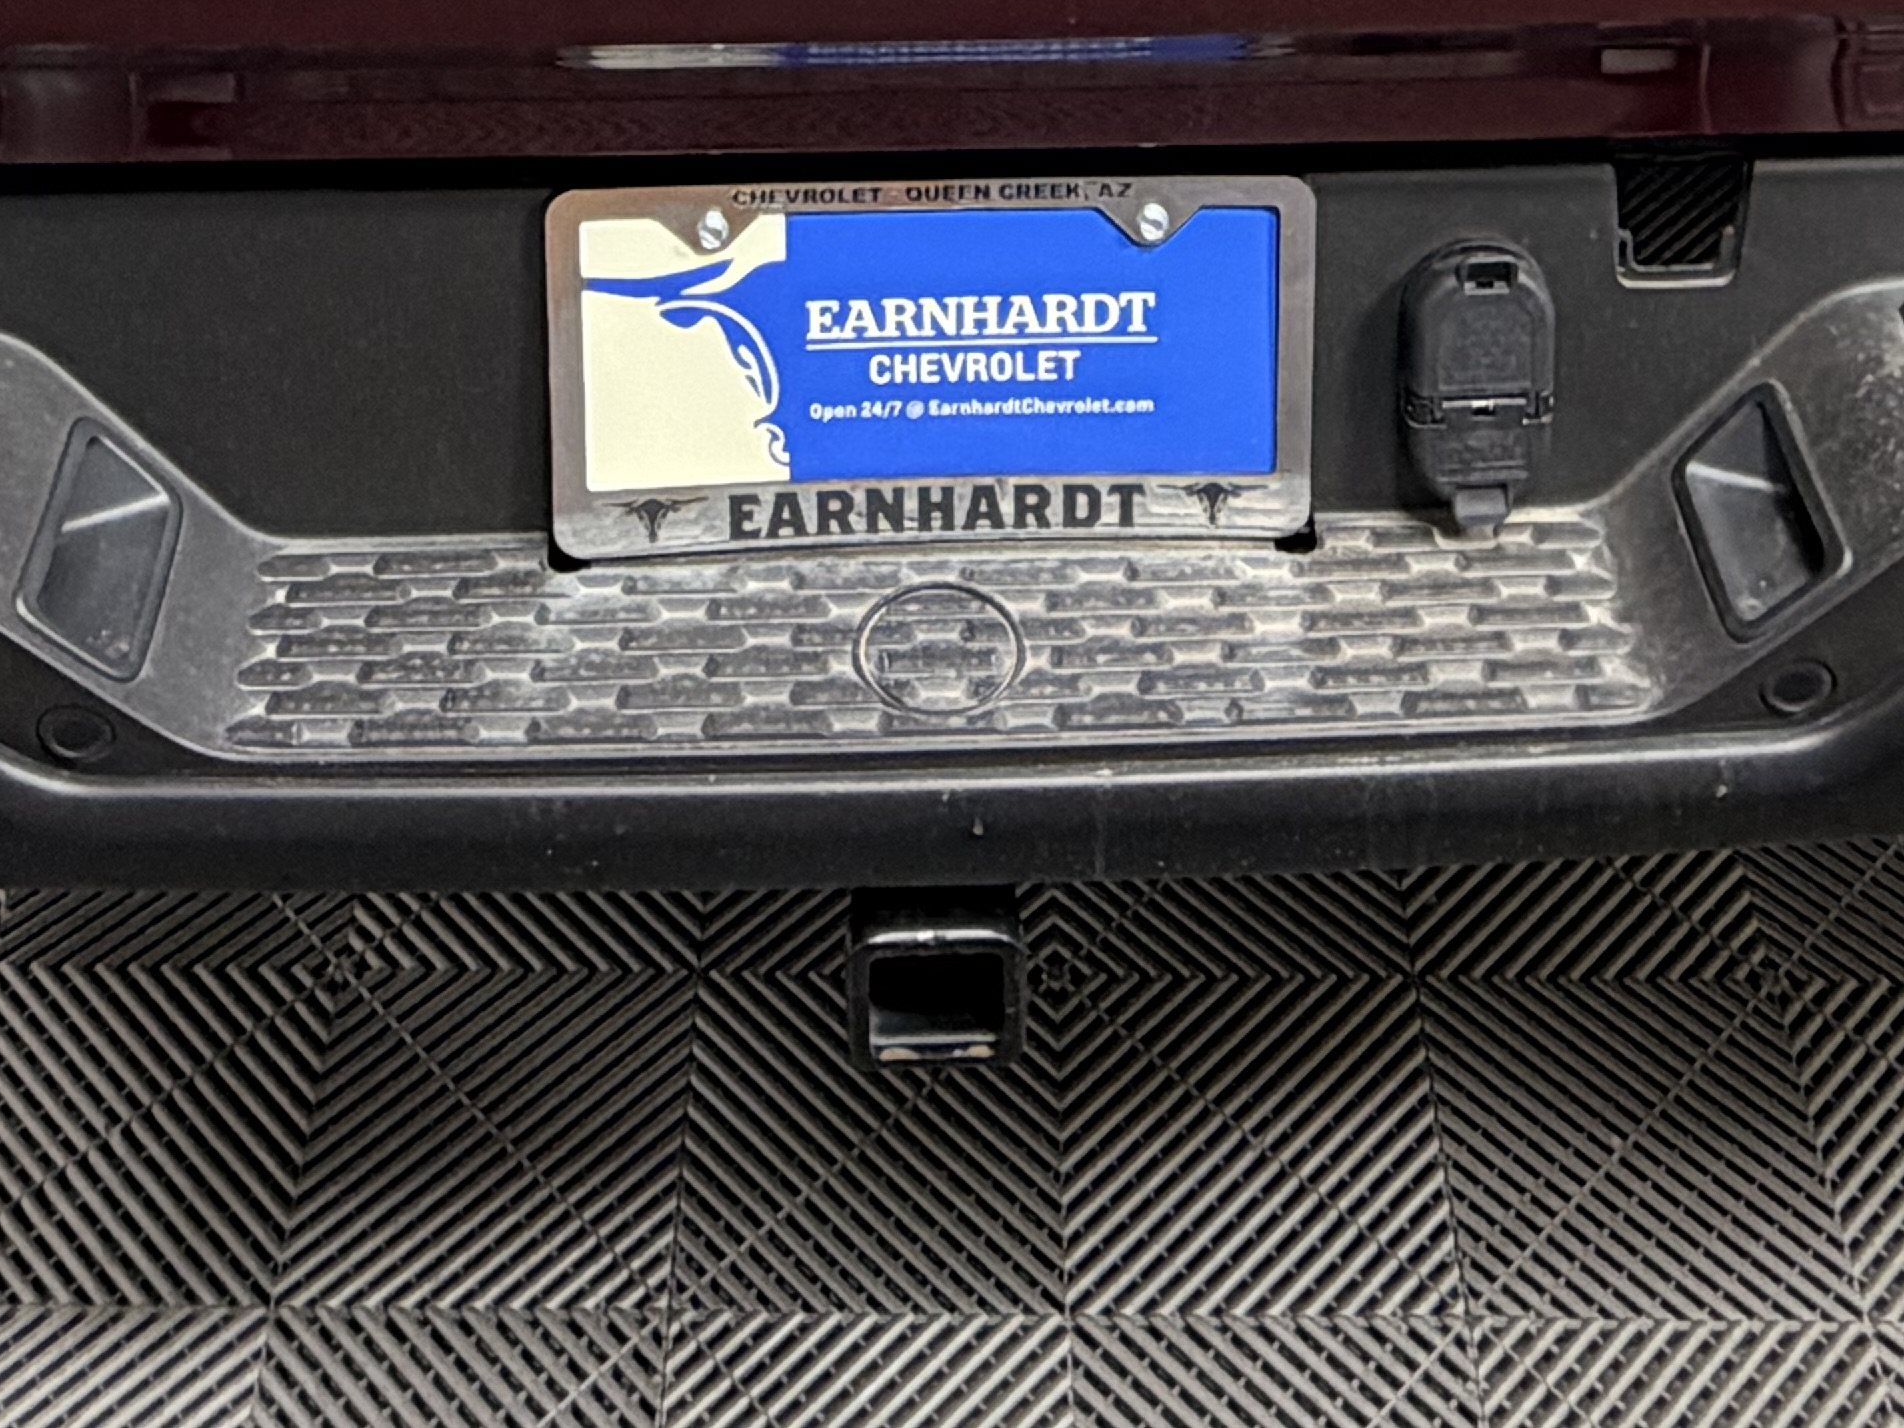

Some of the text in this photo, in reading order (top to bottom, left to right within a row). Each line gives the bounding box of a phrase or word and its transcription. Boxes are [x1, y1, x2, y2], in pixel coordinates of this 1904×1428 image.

[731, 186, 881, 206] CHEVROLET
[1098, 181, 1133, 199] AZ
[805, 292, 1156, 340] EARNHARDT
[869, 350, 1081, 385] CHEVROLET
[809, 403, 858, 423] Open
[860, 401, 902, 420] 24/7
[928, 396, 1156, 417] EarnhardtChevrolet.com
[728, 483, 1146, 540] EARNHARDT
